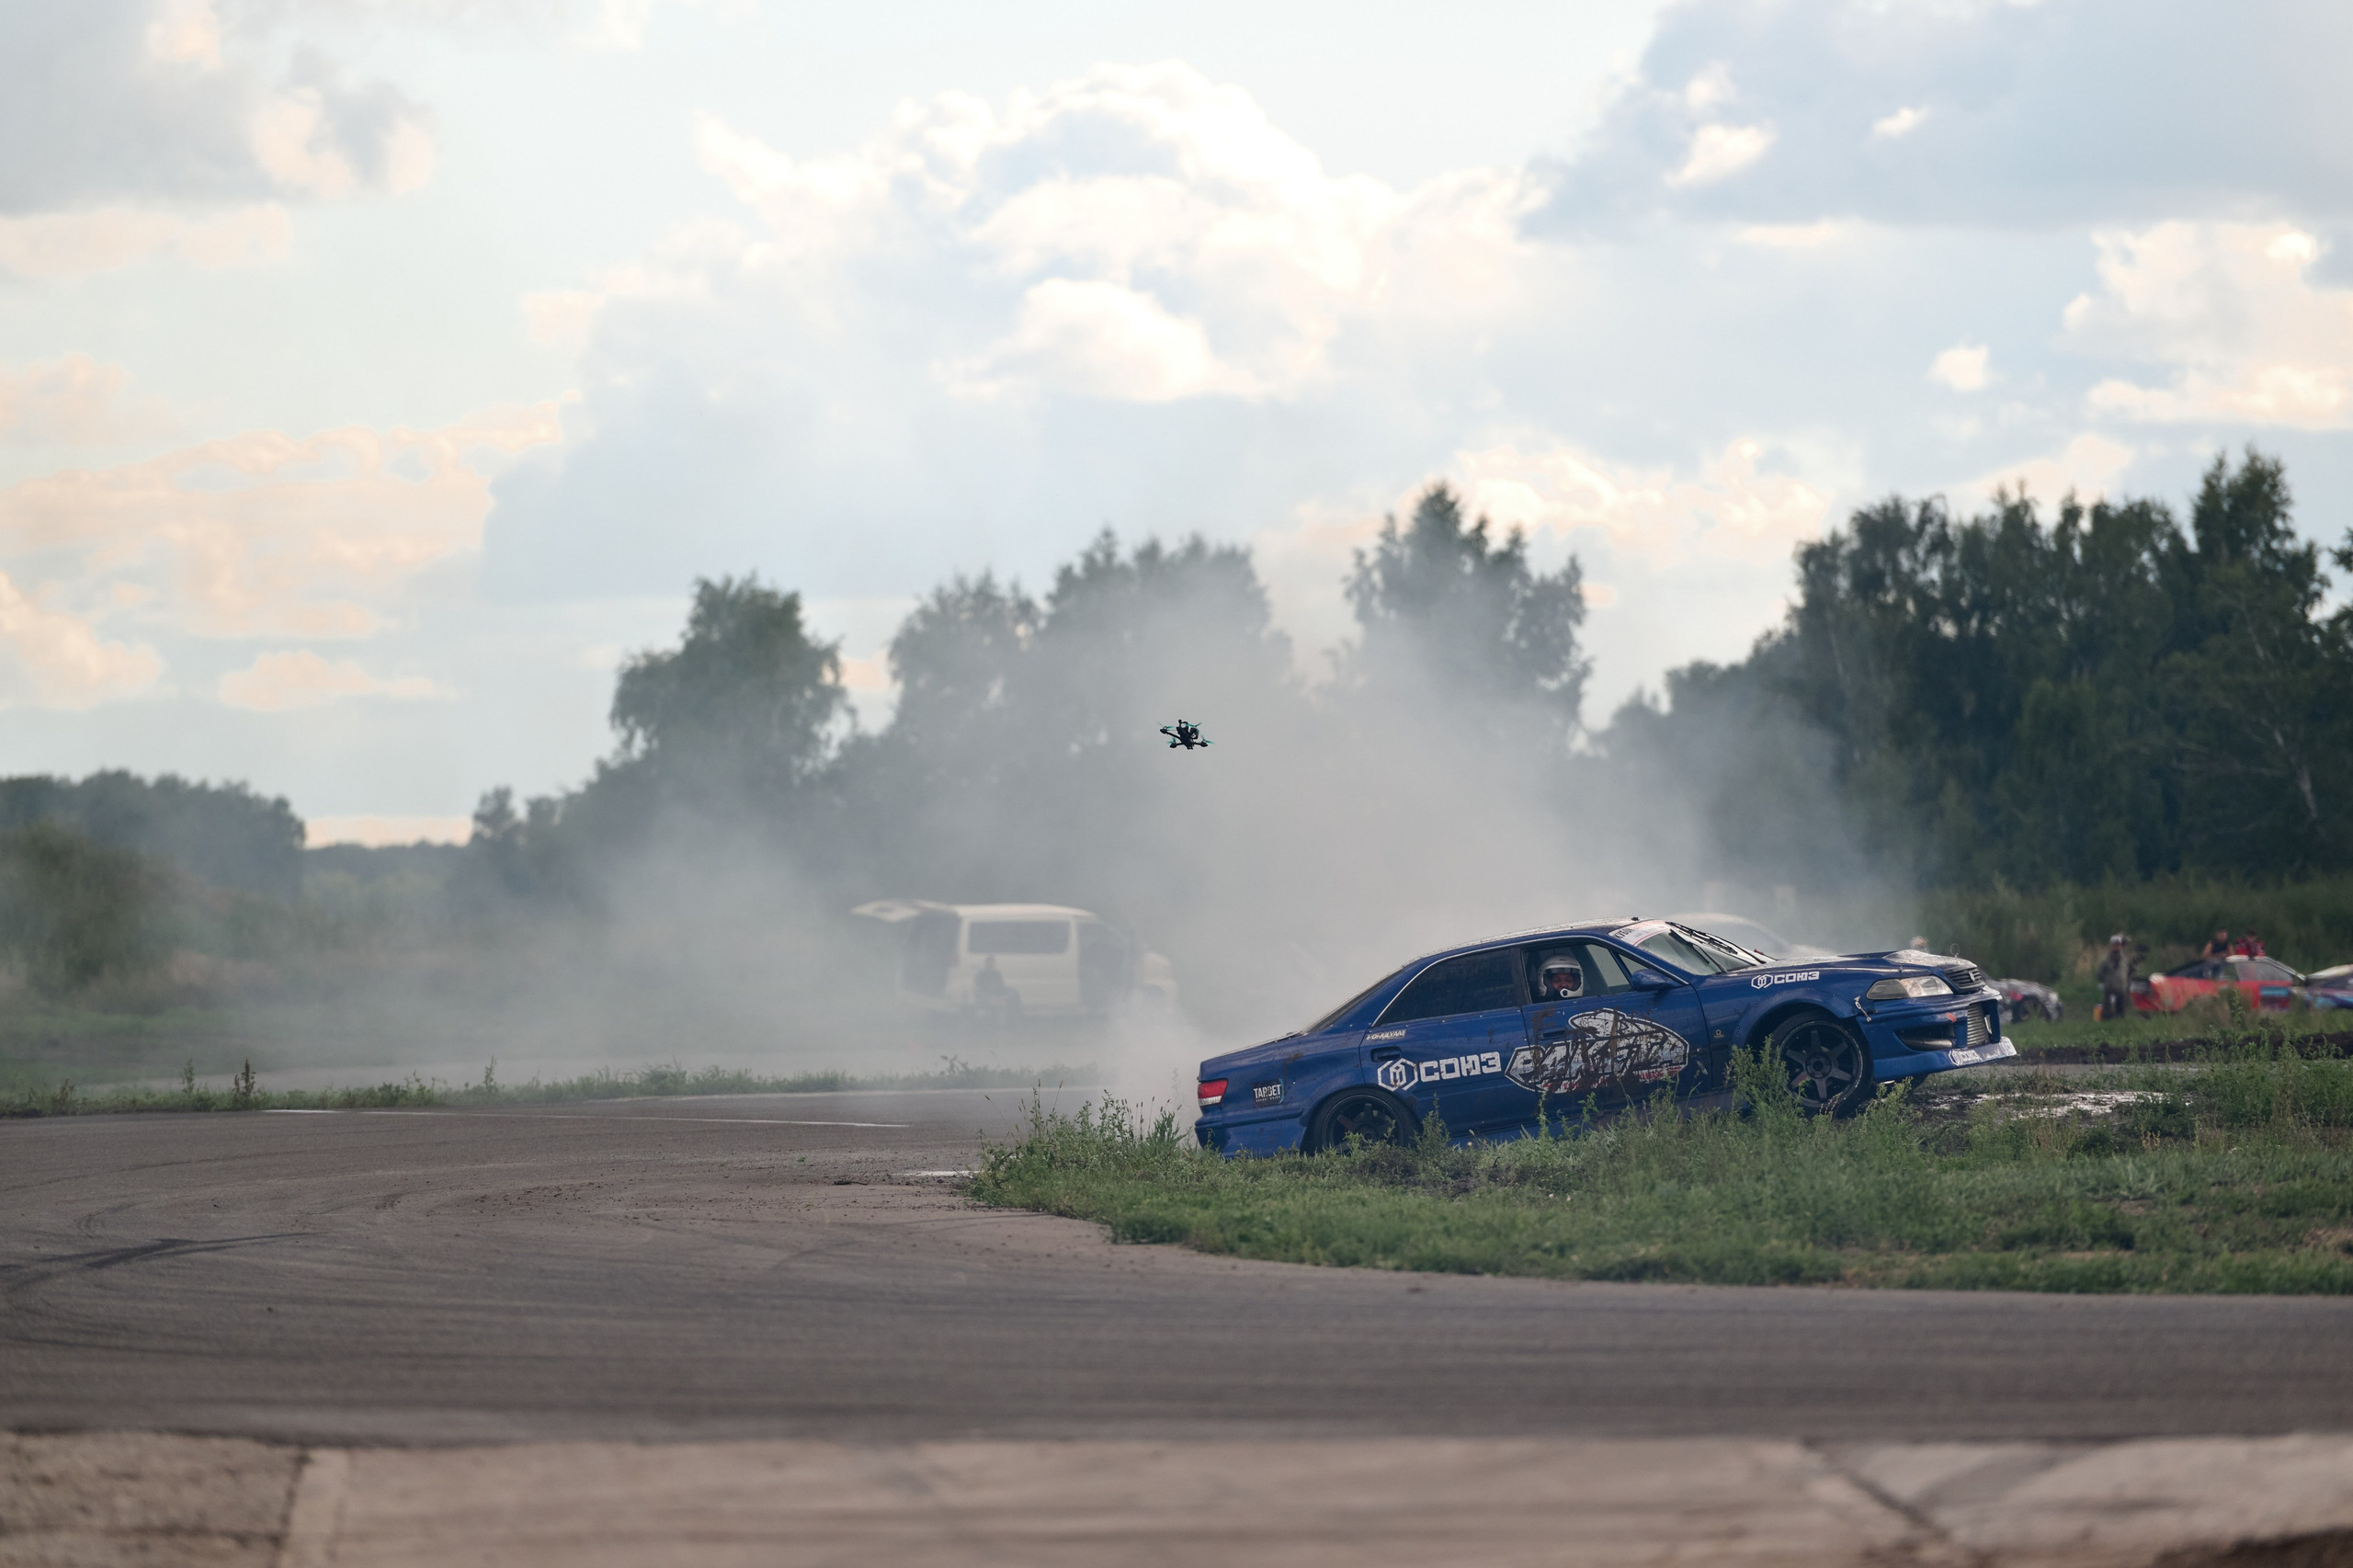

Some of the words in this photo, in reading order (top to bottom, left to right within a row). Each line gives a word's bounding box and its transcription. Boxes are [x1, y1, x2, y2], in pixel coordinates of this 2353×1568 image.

[1773, 971, 1820, 984] СОЮЗ
[1419, 1051, 1502, 1083] СОЮЗ
[1253, 1085, 1281, 1098] TARGET
